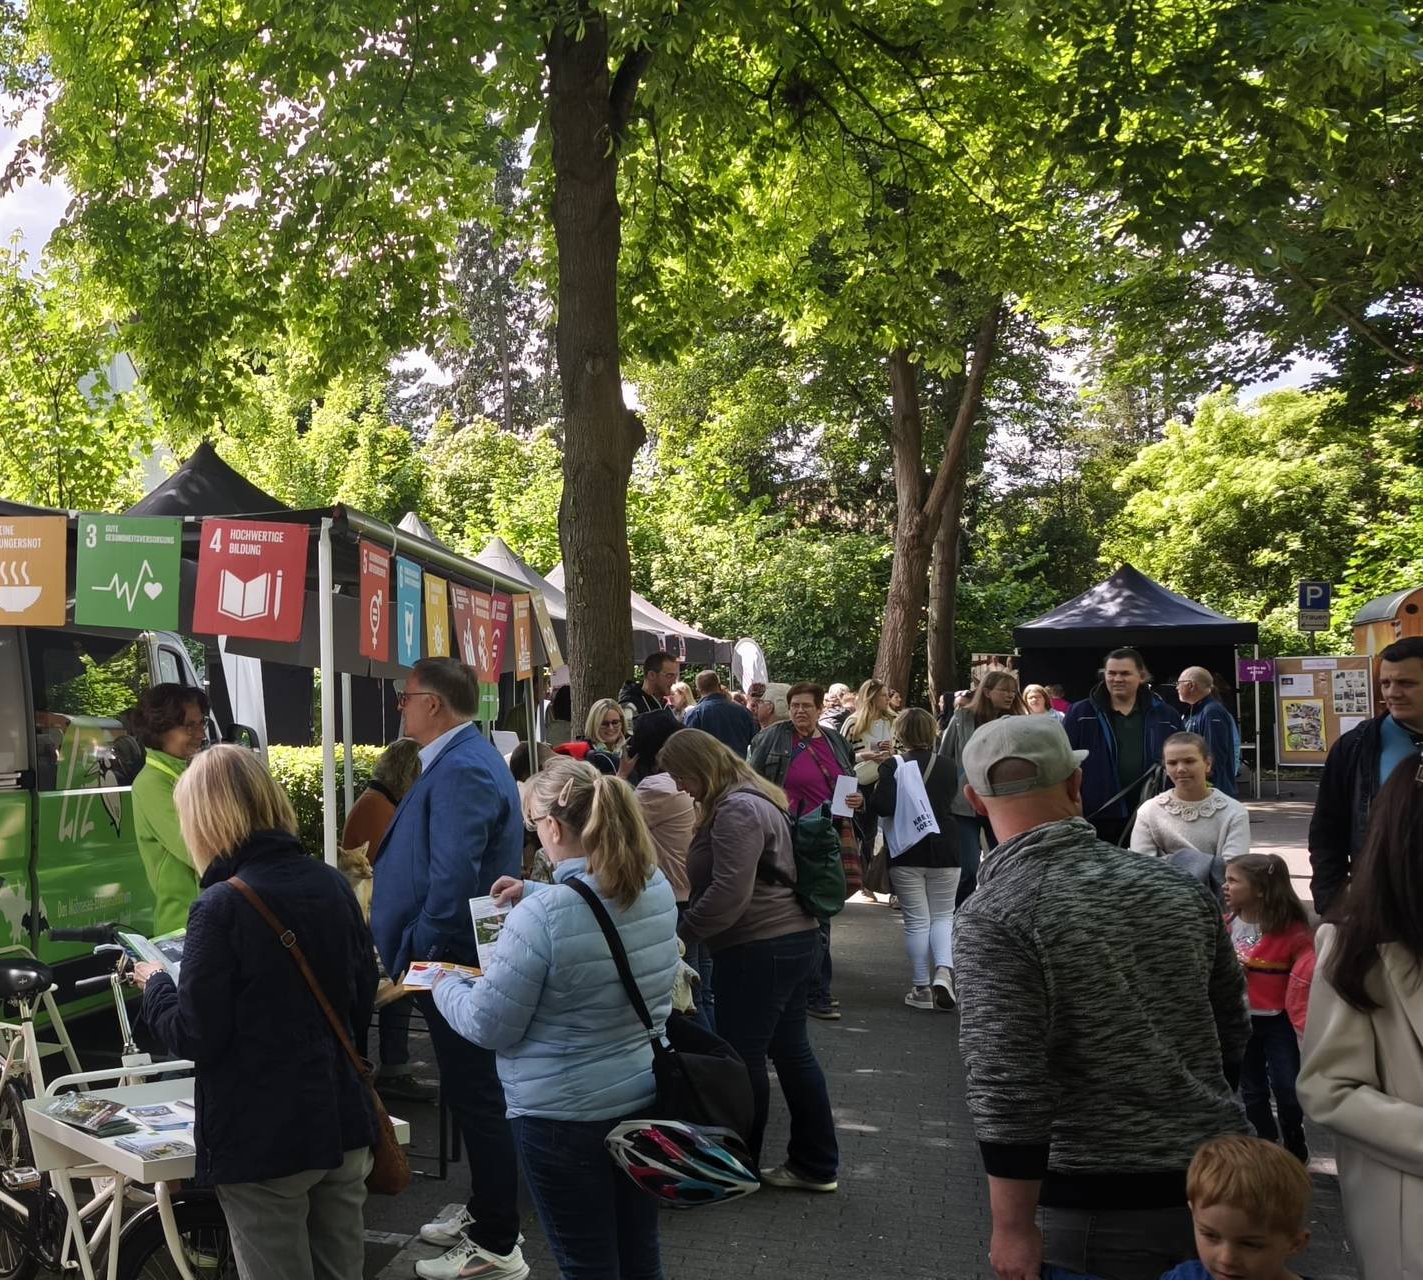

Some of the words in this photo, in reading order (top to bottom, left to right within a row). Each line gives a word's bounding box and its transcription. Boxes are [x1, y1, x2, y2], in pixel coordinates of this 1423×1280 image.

[86, 523, 97, 549] 3
[105, 524, 119, 533] GUTE
[209, 527, 222, 553] 4
[230, 528, 285, 543] HOCHWERTIGE
[228, 542, 261, 556] BILDUNG
[1306, 585, 1323, 606] P
[1301, 613, 1328, 621] Frauen
[916, 820, 933, 833] SOES
